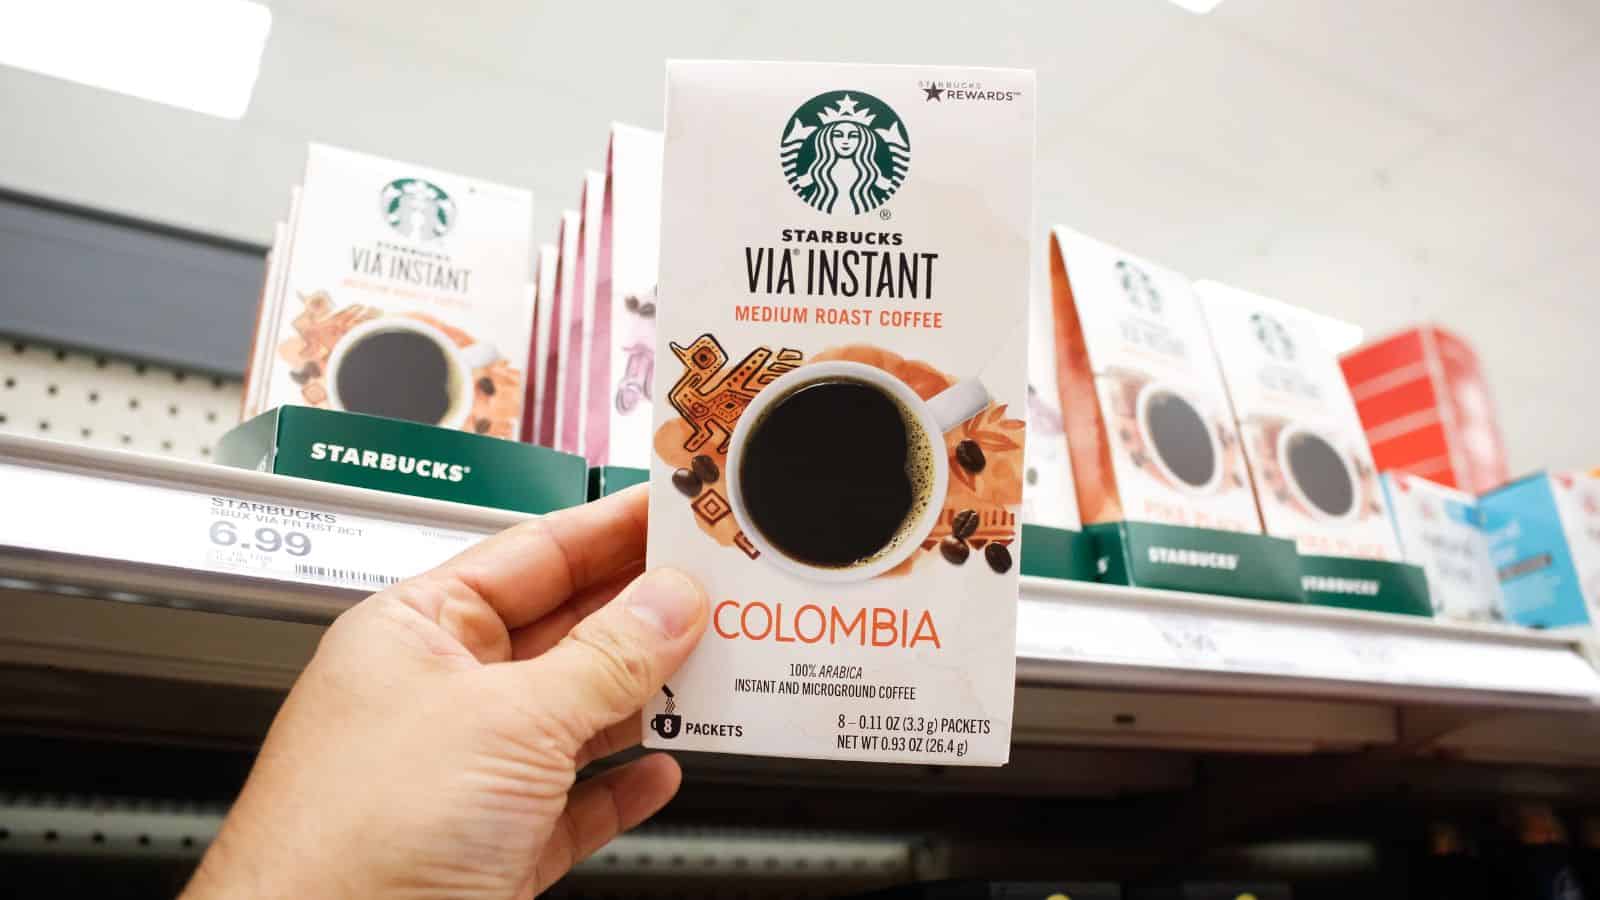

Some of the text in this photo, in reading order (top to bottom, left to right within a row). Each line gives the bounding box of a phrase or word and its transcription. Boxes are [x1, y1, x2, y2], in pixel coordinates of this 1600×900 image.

[781, 229, 903, 246] STARBUCKS
[351, 246, 383, 276] VIA
[389, 256, 472, 293] INSTANT
[807, 249, 939, 300] INSTANT
[735, 305, 943, 329] MEDIUM ROAST COFFEE
[211, 496, 337, 524] STARBUCKS
[256, 514, 279, 524] VIA
[208, 520, 312, 557] 6.99
[713, 600, 941, 649] COLOMBIA
[789, 663, 863, 680] 100% ARABICA
[734, 678, 917, 701] INSTANT AND MICROGROUND COFFEE
[663, 718, 744, 737] 8 PACKETS
[838, 713, 846, 729] 8
[859, 714, 882, 730] 0.11
[886, 716, 901, 731] OZ
[903, 716, 925, 732] (3.3
[927, 718, 938, 735] g)
[940, 718, 991, 734] PACKETS
[837, 734, 968, 757] NET WT 0.93 OZ (26.4 g)
